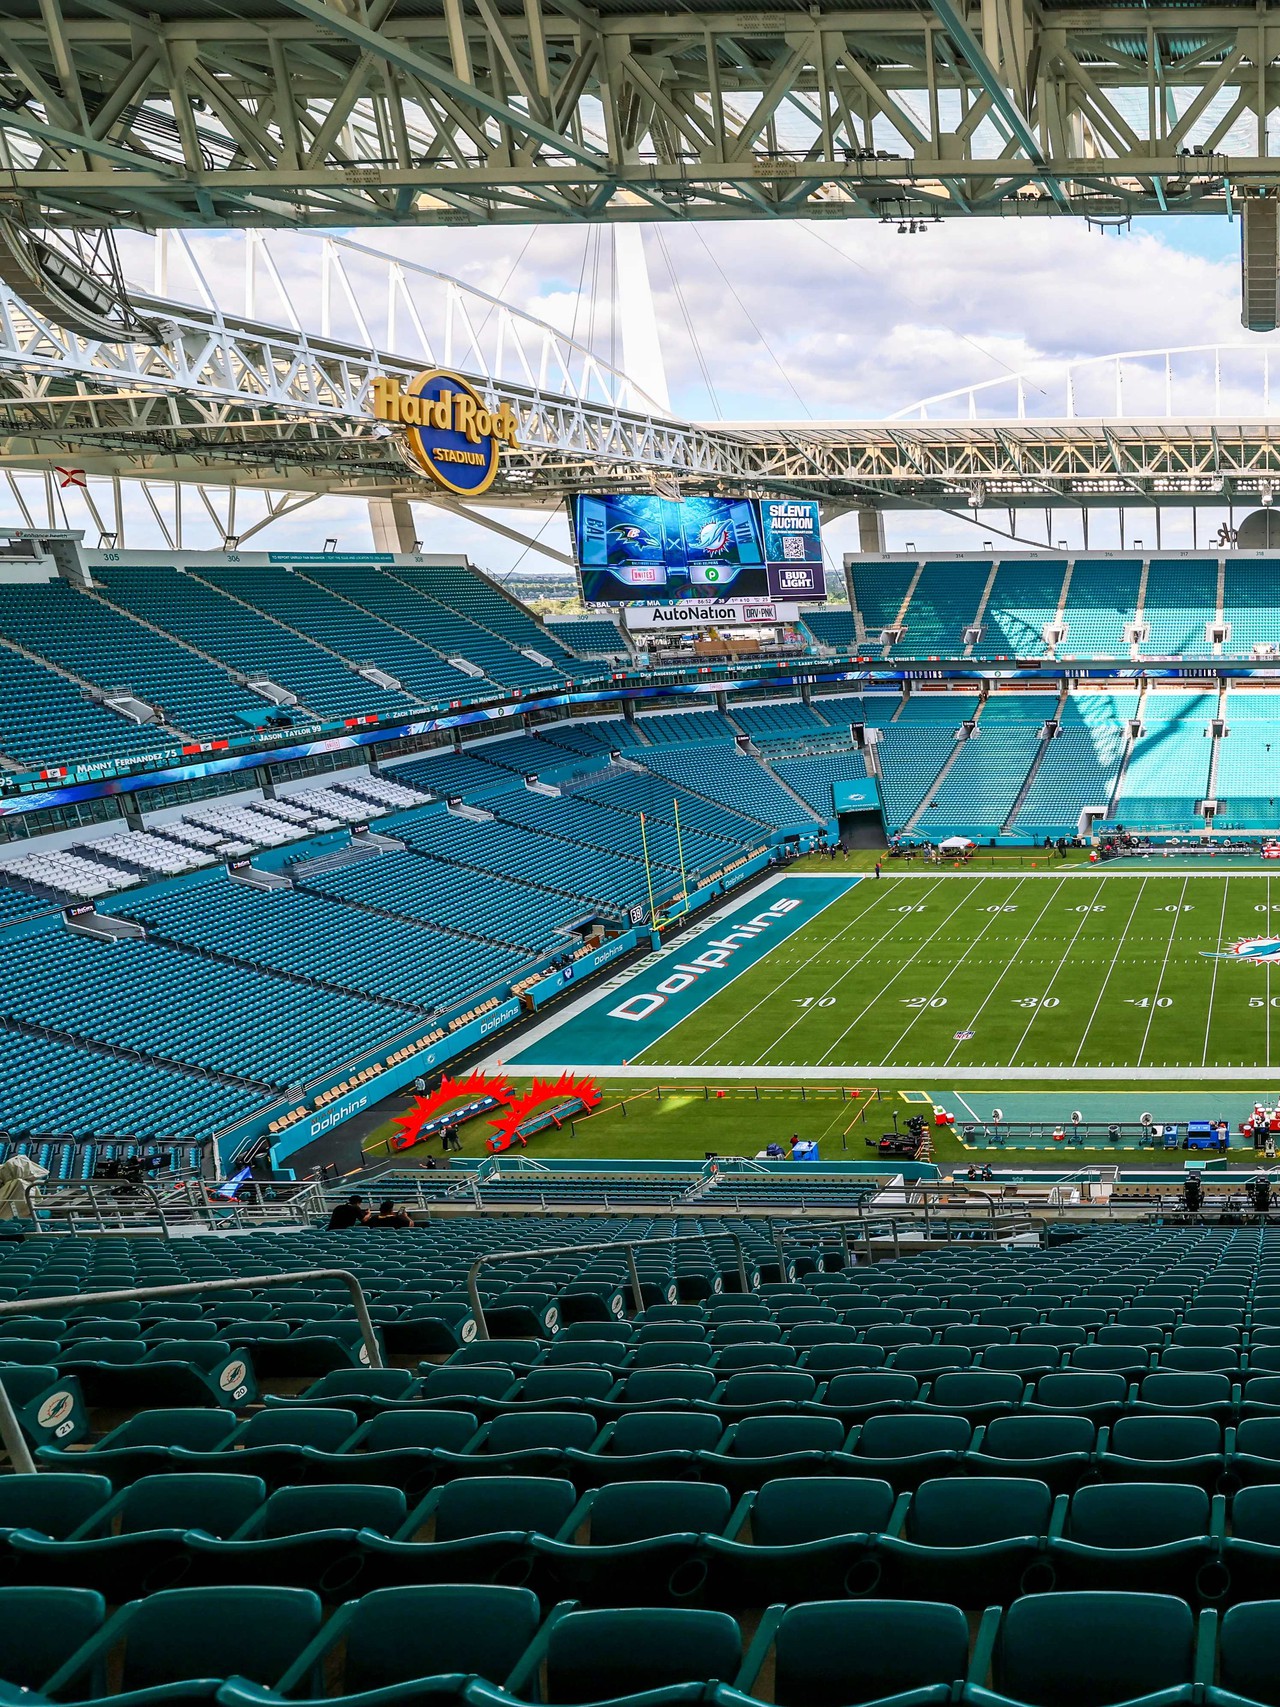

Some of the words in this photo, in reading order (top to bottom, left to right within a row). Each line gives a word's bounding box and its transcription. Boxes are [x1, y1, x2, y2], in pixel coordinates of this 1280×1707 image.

[370, 376, 451, 430] Hard
[451, 393, 521, 449] Rock
[433, 448, 486, 466] STADIUM
[769, 505, 812, 517] SILENT
[585, 517, 604, 542] BAL
[771, 517, 813, 529] AUCTION
[736, 521, 753, 544] MIA
[103, 553, 120, 561] 305
[782, 579, 812, 588] LIGHT
[653, 607, 735, 621] AutoNation
[392, 710, 409, 719] ZACH
[409, 705, 431, 716] THOMAS
[258, 732, 283, 742] JASON
[284, 728, 311, 738] TAYLOR
[312, 725, 322, 733] 99
[77, 761, 112, 774] MANNY
[114, 753, 163, 767] FERNANDEZ
[164, 750, 178, 759] 75
[725, 871, 744, 888] Dolphins
[633, 908, 642, 920] 38
[594, 944, 623, 966] Dolphins
[600, 981, 622, 991] IT
[622, 953, 666, 978] TAKES
[663, 936, 690, 951] ALL
[689, 926, 706, 938] OF
[705, 915, 723, 927] US
[607, 898, 802, 1022] Dolphins
[797, 997, 837, 1008] 10
[905, 997, 948, 1008] 20
[1019, 997, 1060, 1008] 30
[1134, 997, 1173, 1008] 40
[480, 1005, 519, 1034] Dolphins
[311, 1096, 367, 1136] Dolphins
[236, 1388, 246, 1397] 20
[60, 1423, 71, 1434] 21
